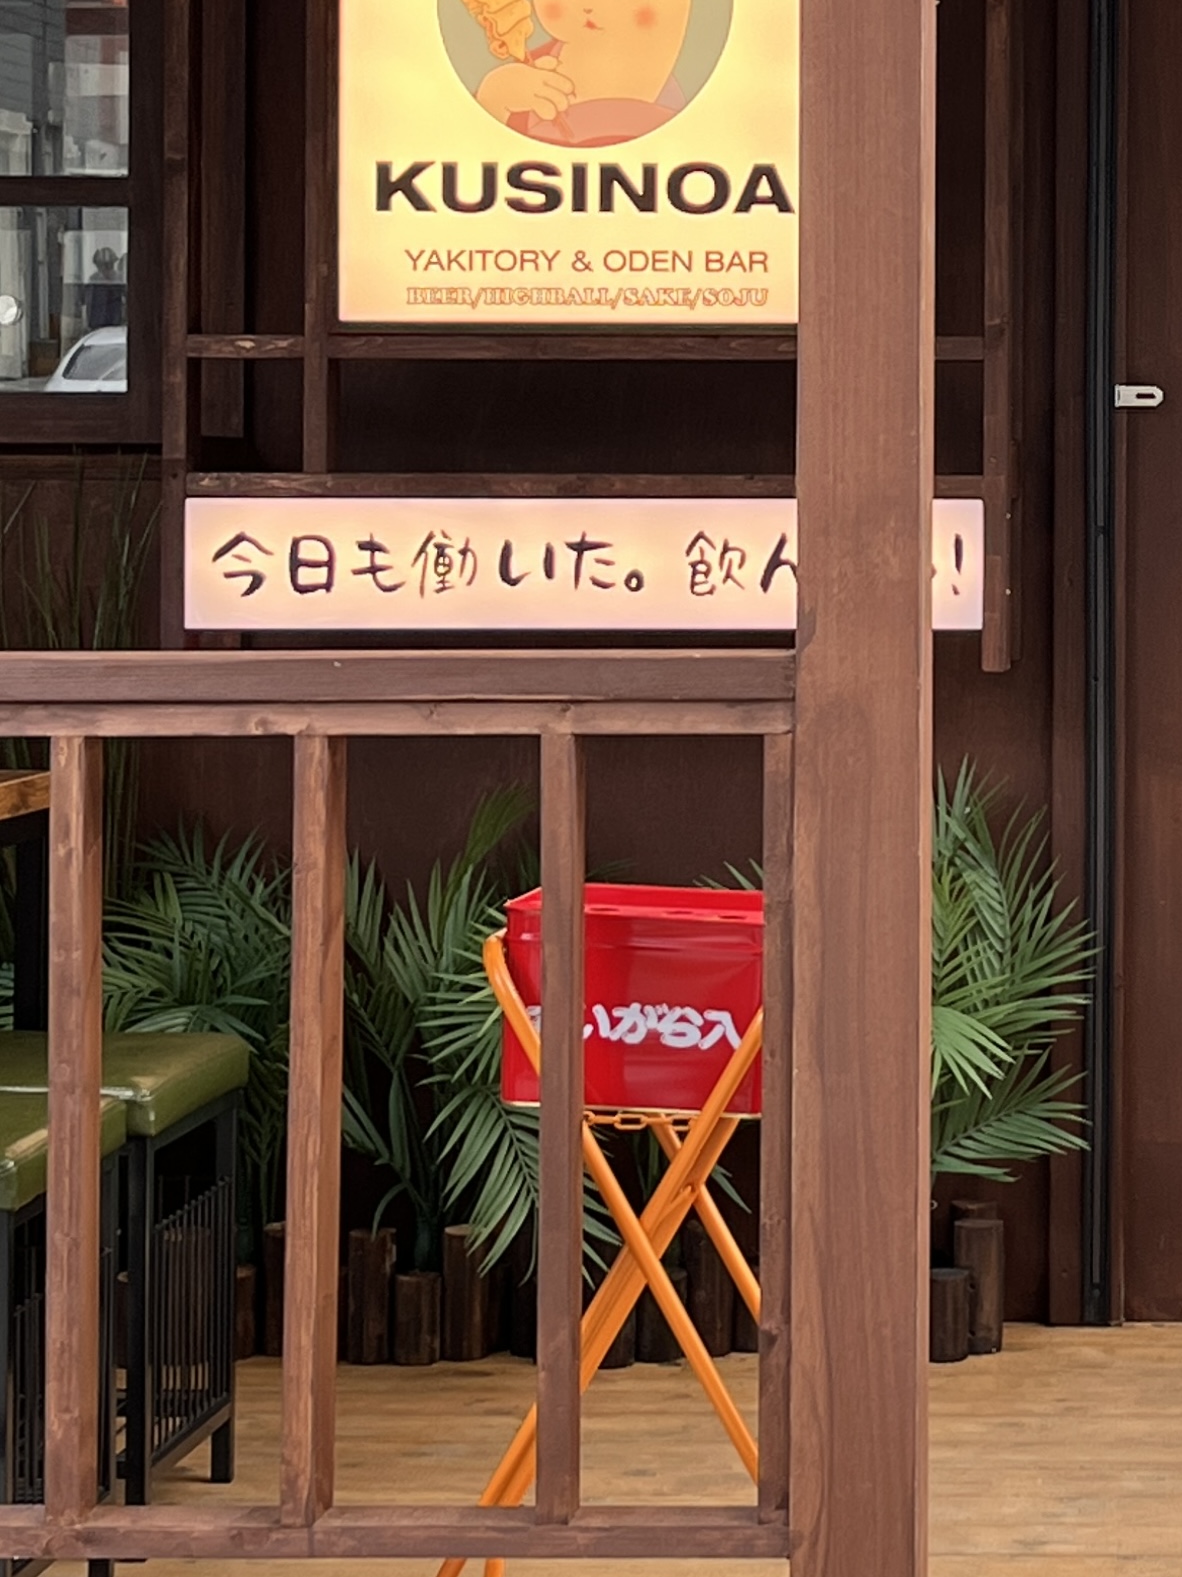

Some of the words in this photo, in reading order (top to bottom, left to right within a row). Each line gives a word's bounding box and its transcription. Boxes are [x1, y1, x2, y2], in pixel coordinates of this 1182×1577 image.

[375, 161, 796, 214] KUSINOA
[404, 249, 561, 272] YAKITORY
[571, 249, 594, 272] &
[603, 249, 693, 272] ODEN
[704, 249, 769, 272] BAR
[406, 286, 769, 310] BEER/HIGHBALL/SAKE/SOJU
[527, 1002, 742, 1052] いがら入
